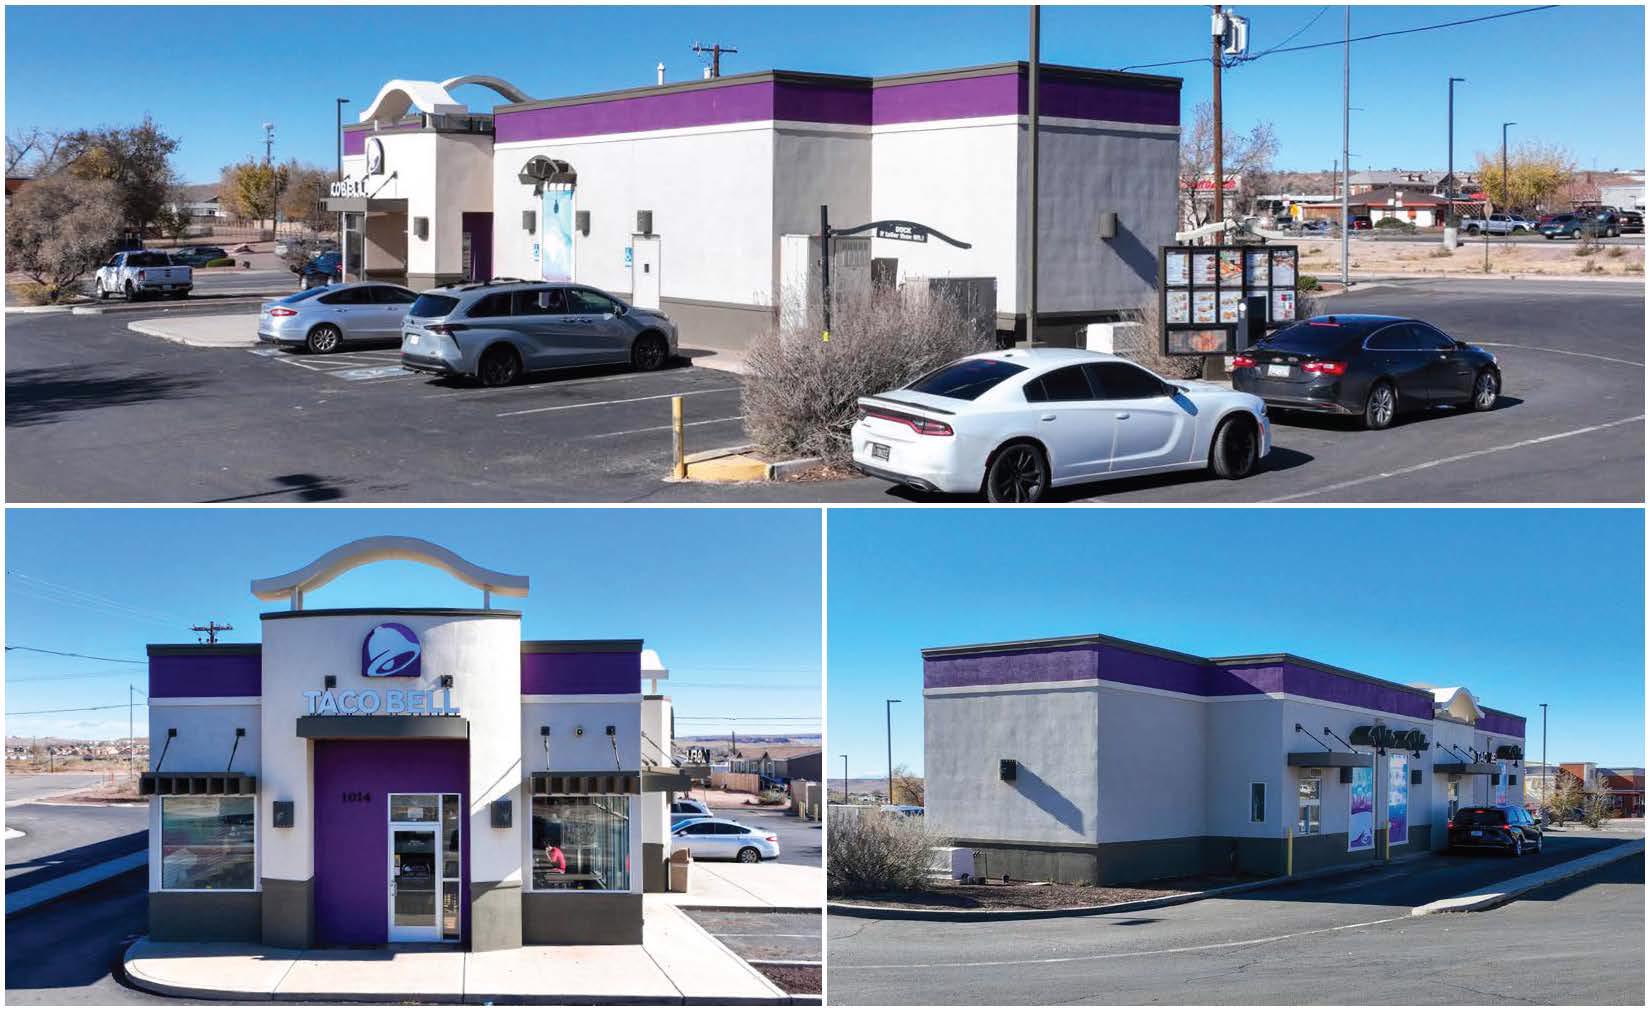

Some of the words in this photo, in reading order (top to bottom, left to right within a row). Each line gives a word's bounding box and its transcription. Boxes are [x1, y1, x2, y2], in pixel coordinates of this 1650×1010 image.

[303, 688, 381, 714] TACO
[385, 689, 460, 714] BELL
[341, 791, 371, 803] 1014
